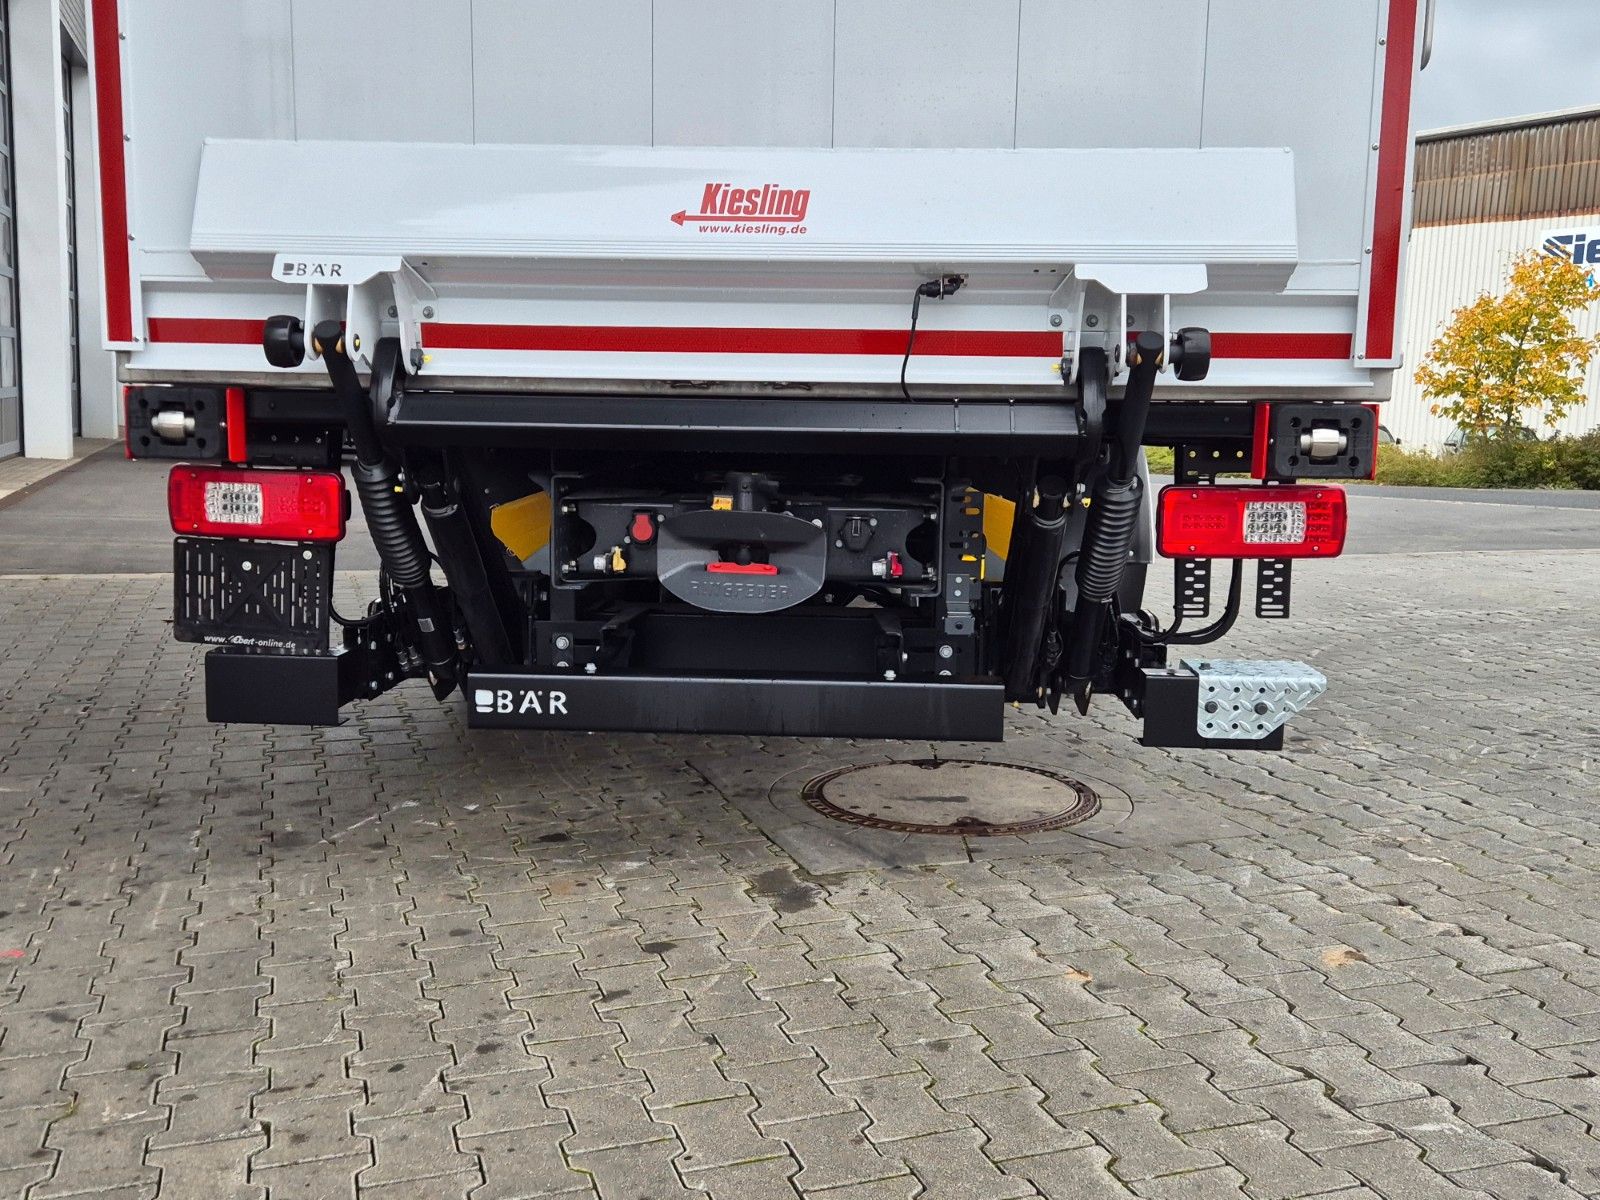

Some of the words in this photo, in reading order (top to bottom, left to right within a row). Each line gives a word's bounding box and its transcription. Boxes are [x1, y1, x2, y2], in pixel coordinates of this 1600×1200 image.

[700, 183, 811, 222] Kiesling
[699, 224, 808, 236] www.kiesling.de
[296, 262, 342, 277] BÄR
[496, 689, 568, 715] BÄR
